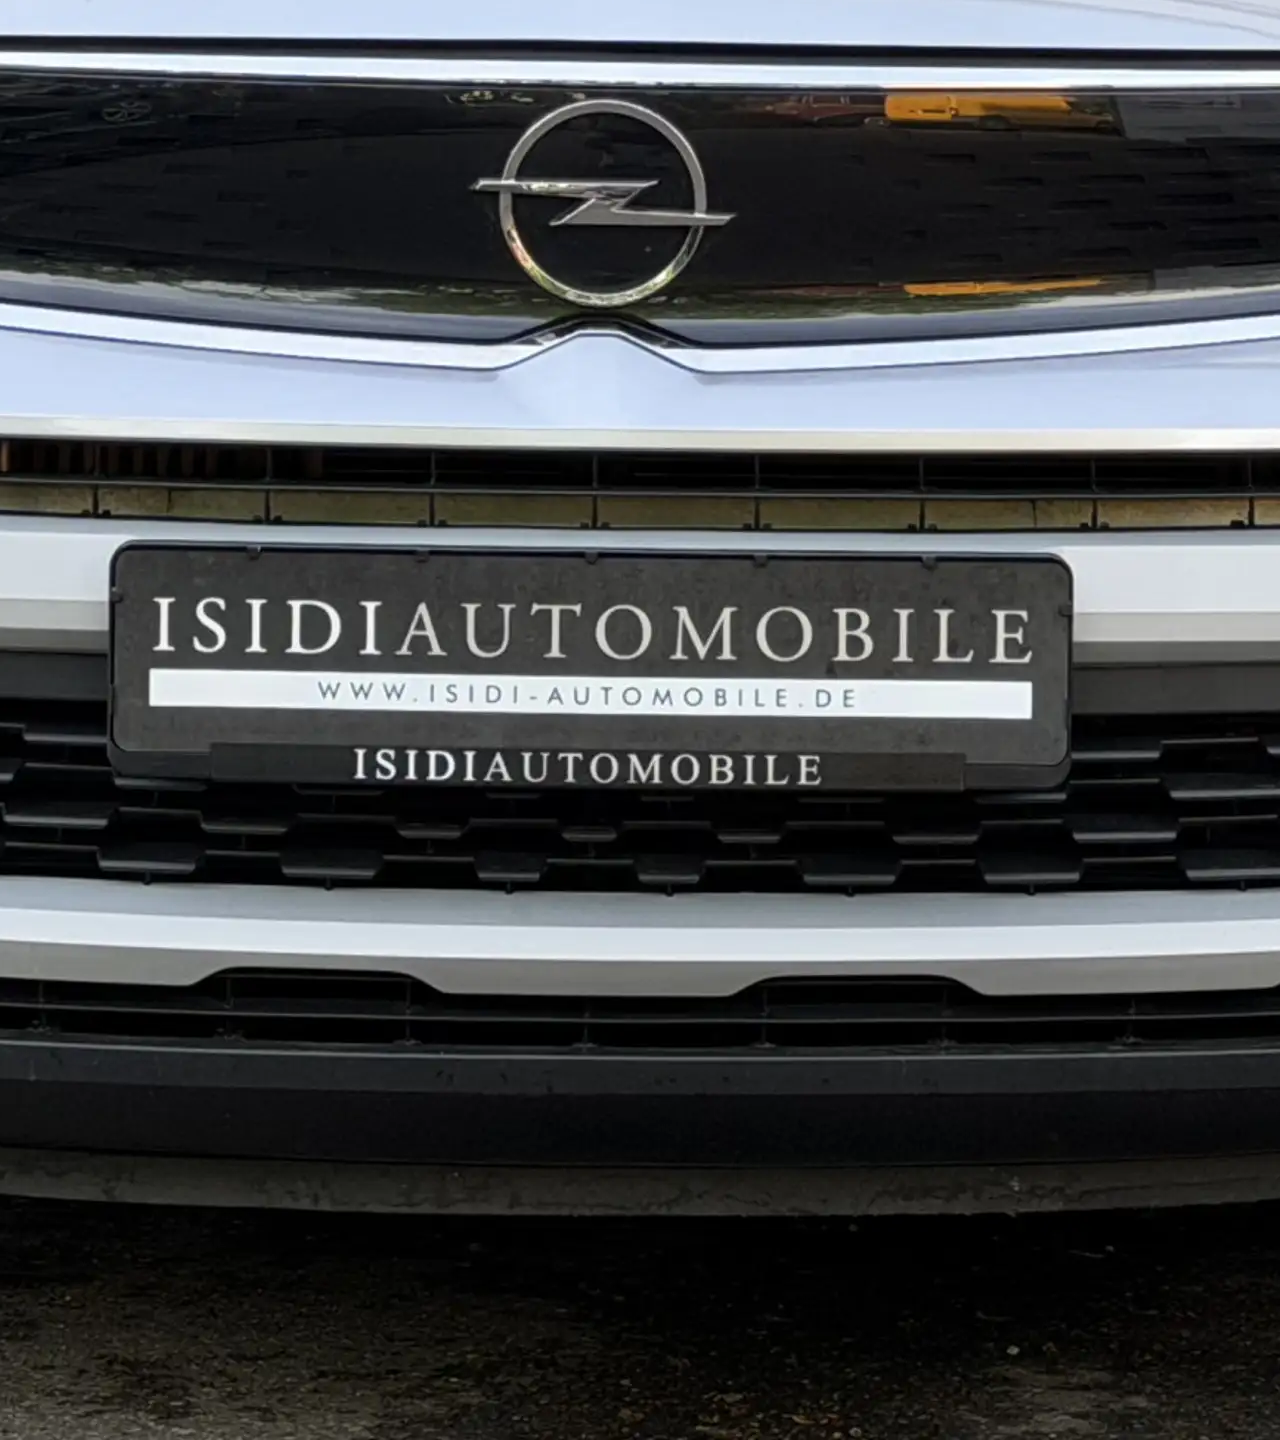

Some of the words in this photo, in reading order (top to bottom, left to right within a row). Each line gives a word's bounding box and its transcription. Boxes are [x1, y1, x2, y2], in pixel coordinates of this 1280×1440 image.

[151, 596, 1033, 664] ISIDIAUTOMOBILE
[318, 681, 857, 709] WWW.ISIDI-AUTOMOBILE.DE
[353, 747, 822, 786] ISIDIAUTOMOBILE
